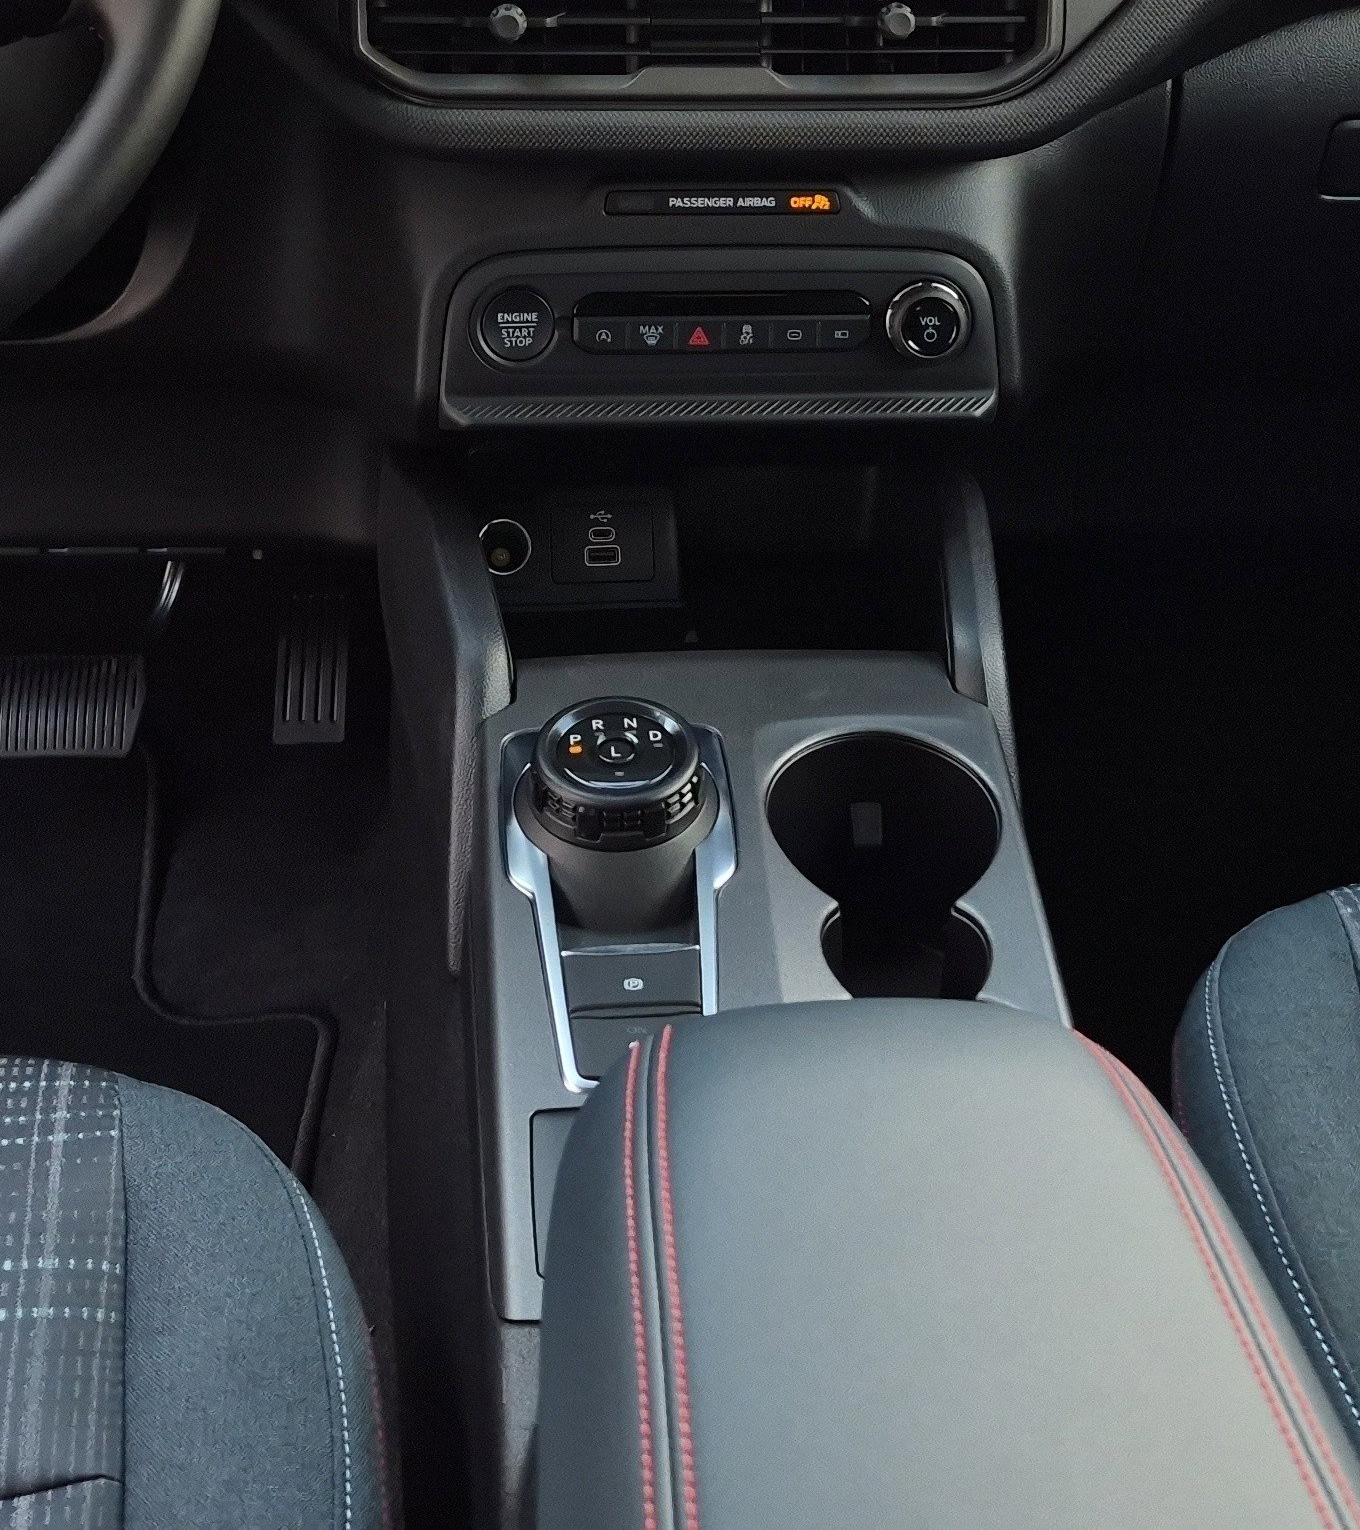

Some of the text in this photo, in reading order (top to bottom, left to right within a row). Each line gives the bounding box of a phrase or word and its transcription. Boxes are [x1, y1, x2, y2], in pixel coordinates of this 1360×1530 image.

[669, 196, 814, 209] PASSENGER AIRBAG OFF
[497, 312, 539, 322] ENGINE
[919, 316, 940, 326] VOL
[501, 328, 535, 338] START
[639, 325, 664, 334] MAX
[504, 338, 533, 347] STOP
[592, 719, 605, 730] R
[624, 717, 638, 728] N
[569, 734, 582, 745] P
[649, 730, 662, 741] D
[610, 745, 622, 757] L
